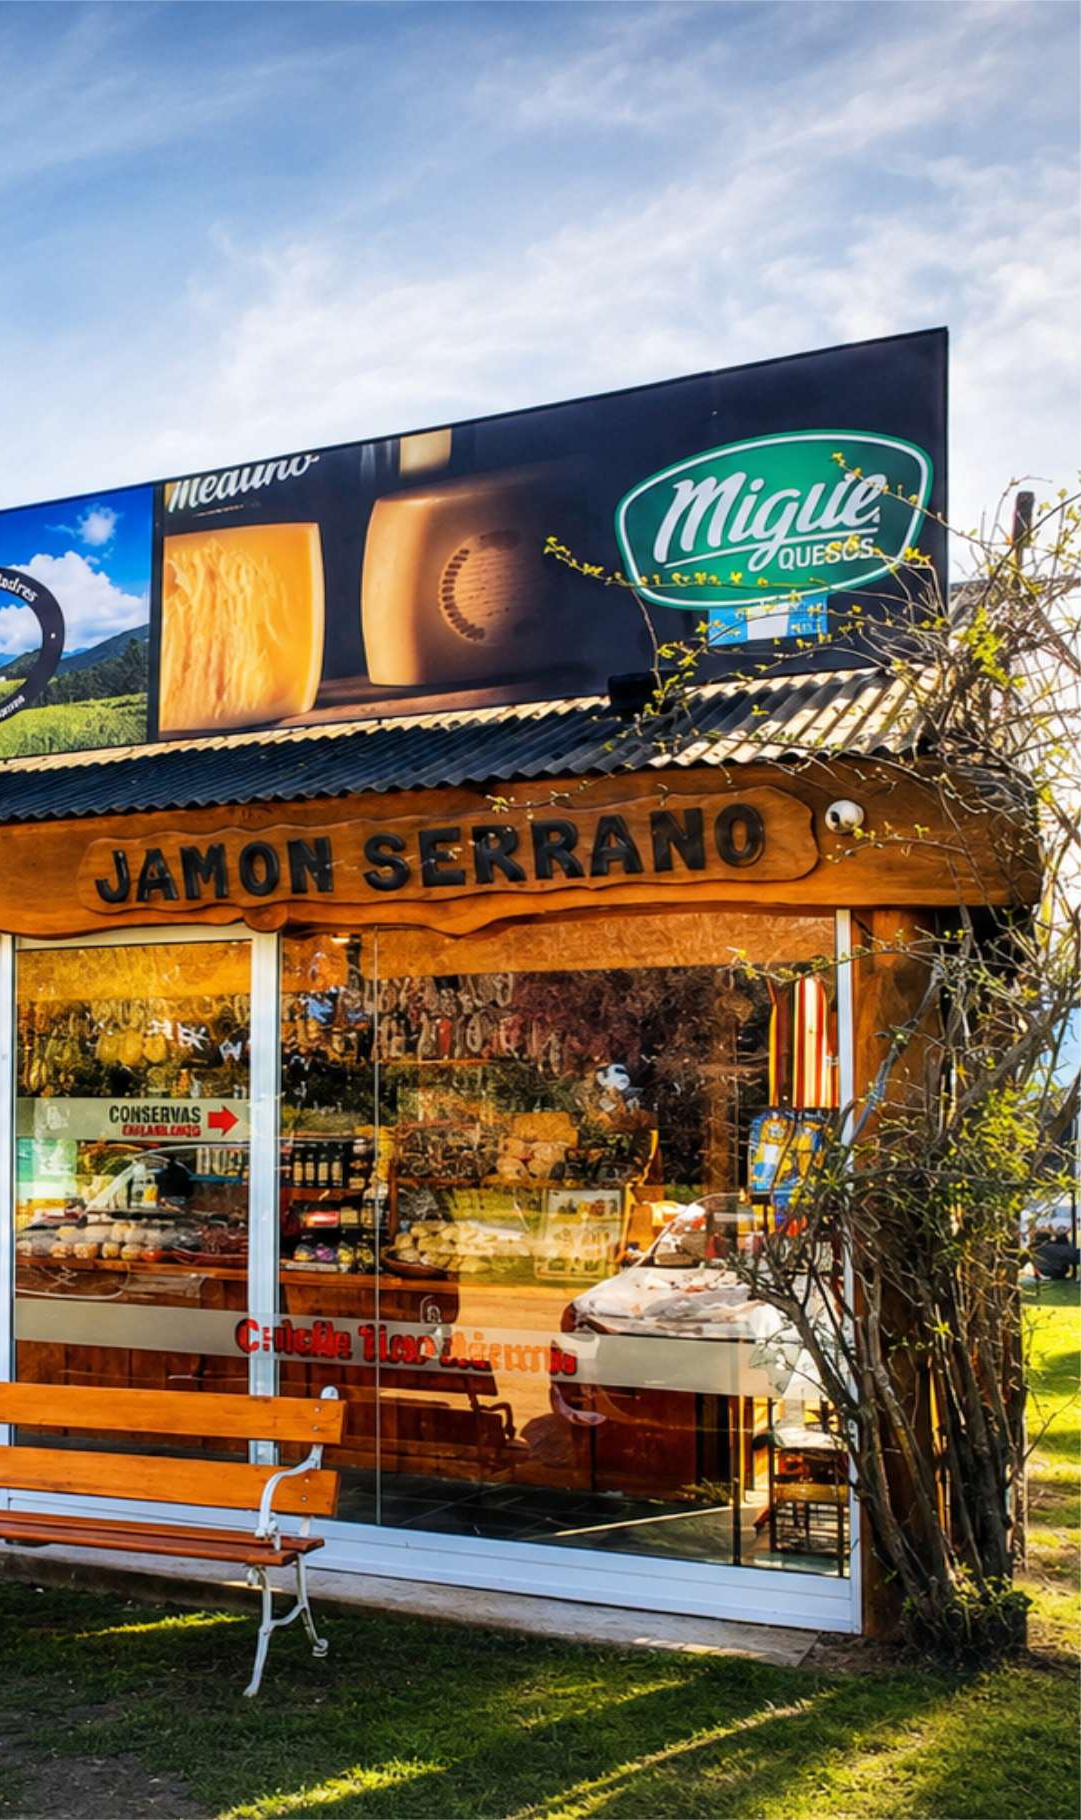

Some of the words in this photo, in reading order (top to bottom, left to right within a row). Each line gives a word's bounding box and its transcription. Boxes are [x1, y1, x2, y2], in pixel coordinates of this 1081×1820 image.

[778, 537, 874, 571] QUESOS
[94, 836, 334, 904] JAMON
[363, 804, 765, 892] SERRANO
[109, 1105, 201, 1124] CONSERVAS
